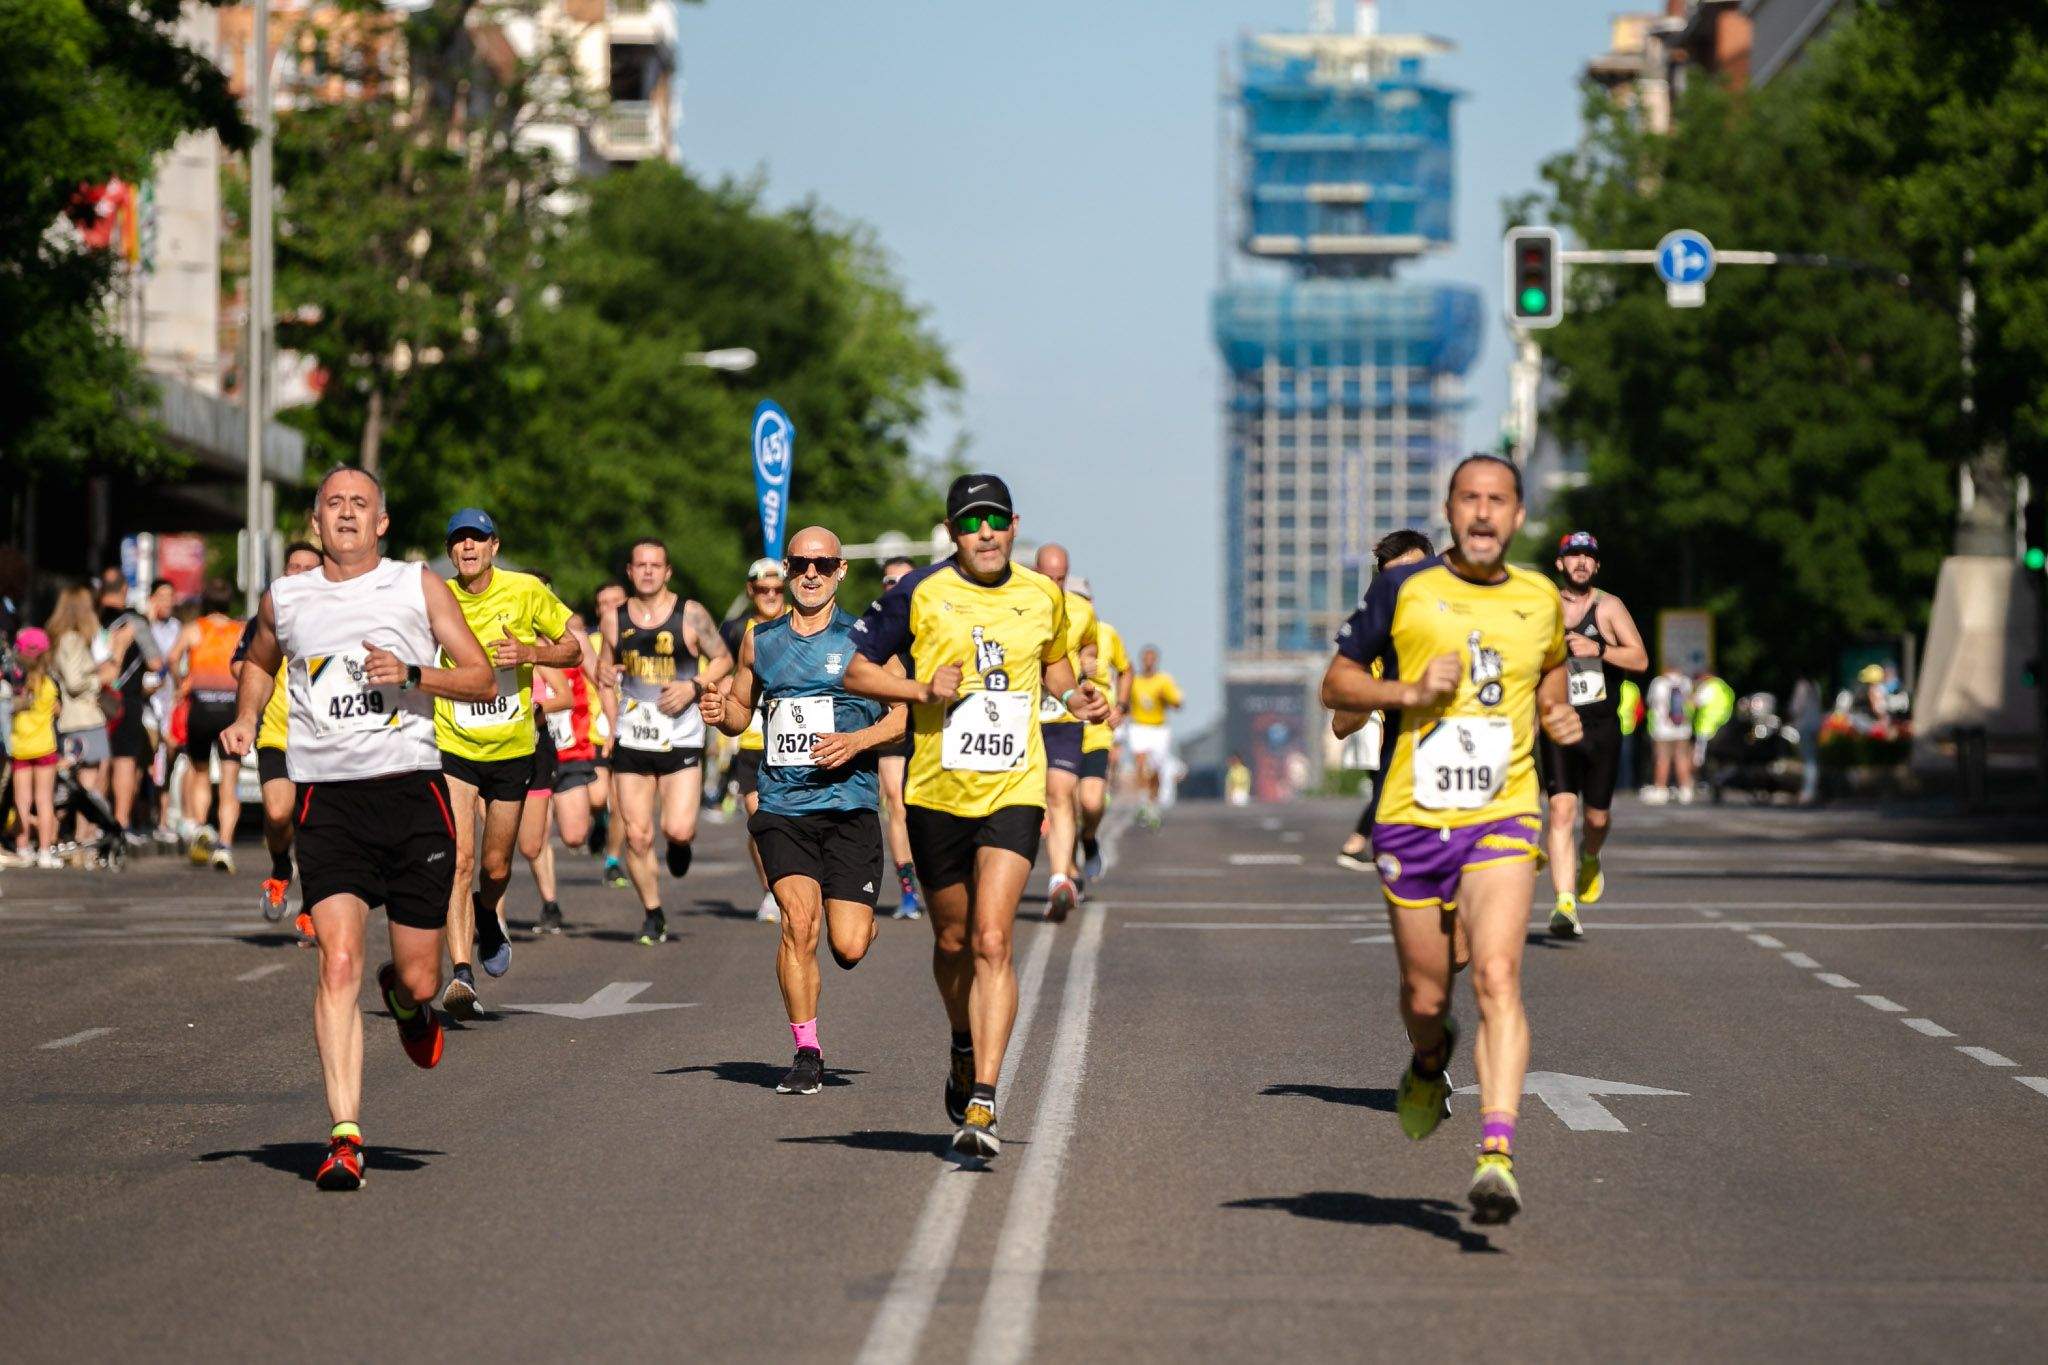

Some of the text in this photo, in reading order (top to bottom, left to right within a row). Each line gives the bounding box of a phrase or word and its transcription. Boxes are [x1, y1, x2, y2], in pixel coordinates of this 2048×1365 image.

[329, 690, 384, 719] 4239
[960, 732, 1014, 755] 2456
[1435, 765, 1491, 791] 3119
